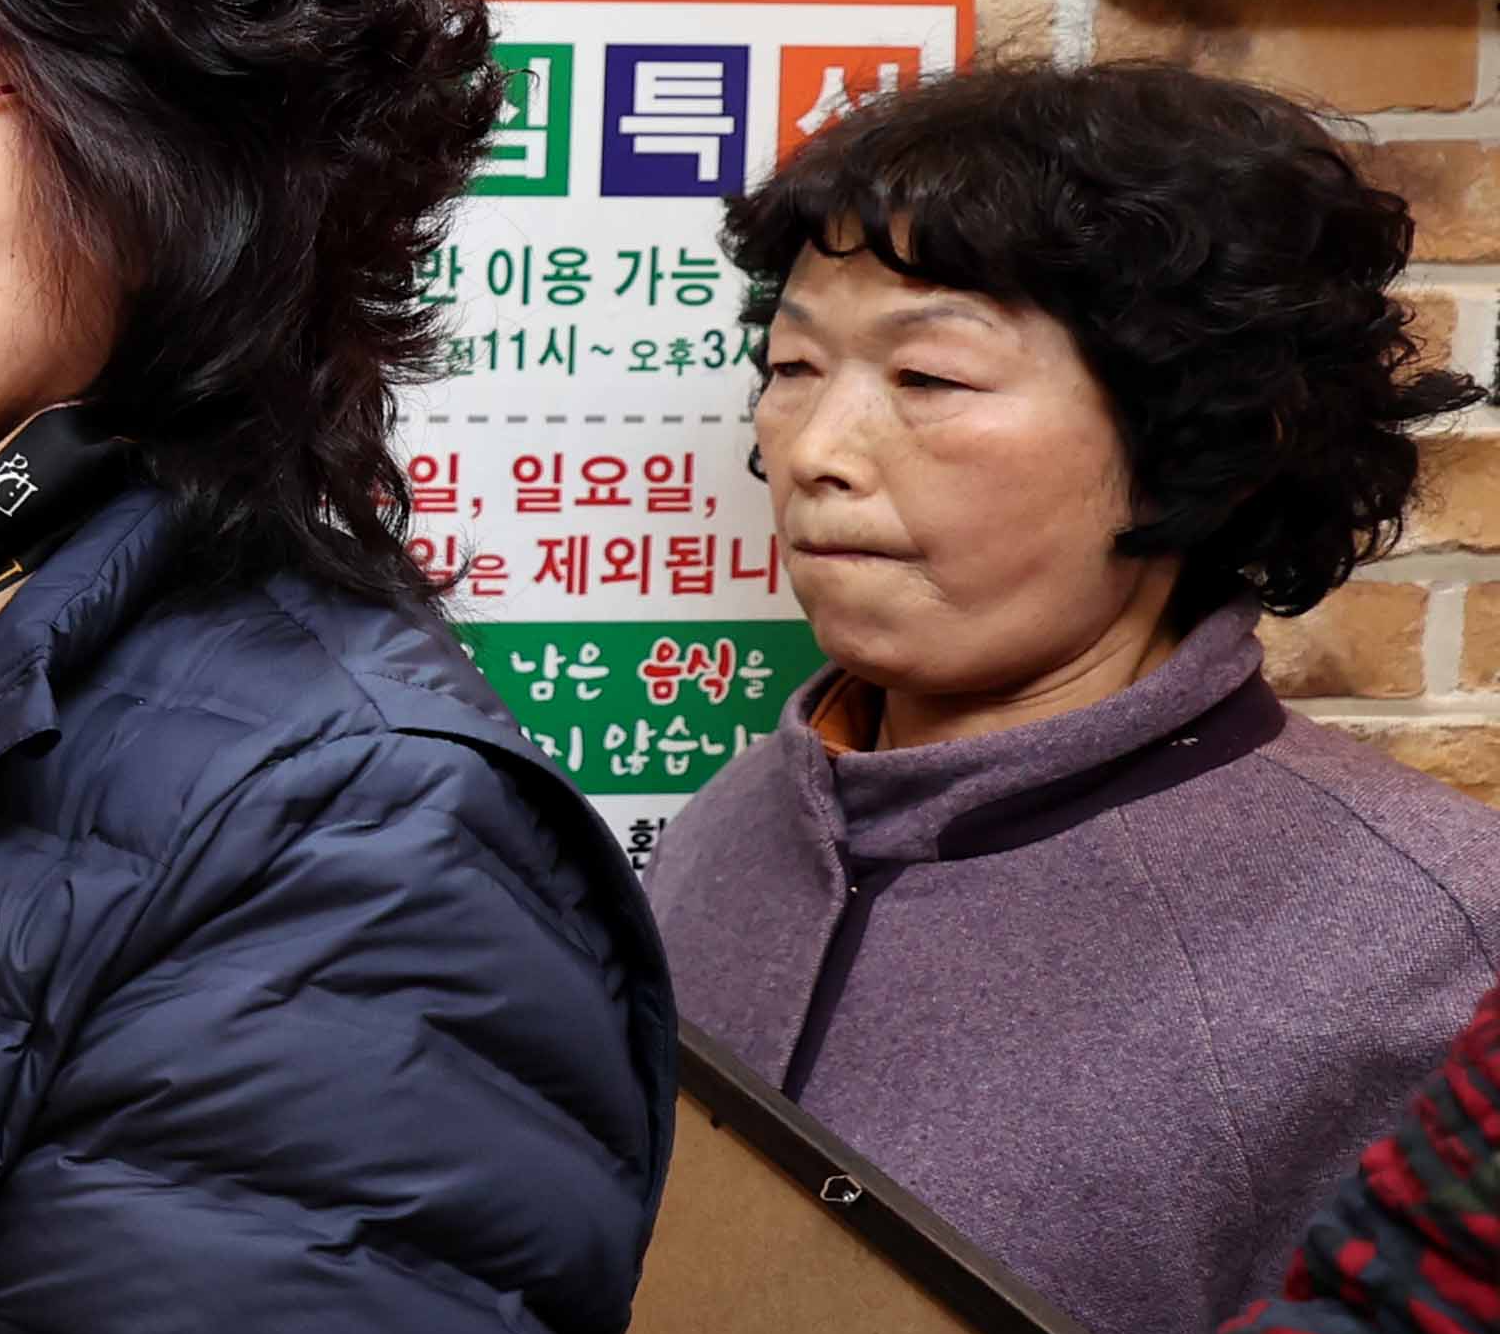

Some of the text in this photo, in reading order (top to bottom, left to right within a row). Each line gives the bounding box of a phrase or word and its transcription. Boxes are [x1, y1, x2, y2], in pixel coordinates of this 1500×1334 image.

[487, 245, 592, 307] 이용
[614, 246, 721, 307] 가능
[512, 452, 718, 517] 일요일,
[534, 534, 780, 596] 제외됩니
[510, 643, 610, 701] 남은
[637, 637, 773, 705] 음식을
[603, 716, 770, 776] 않습니
